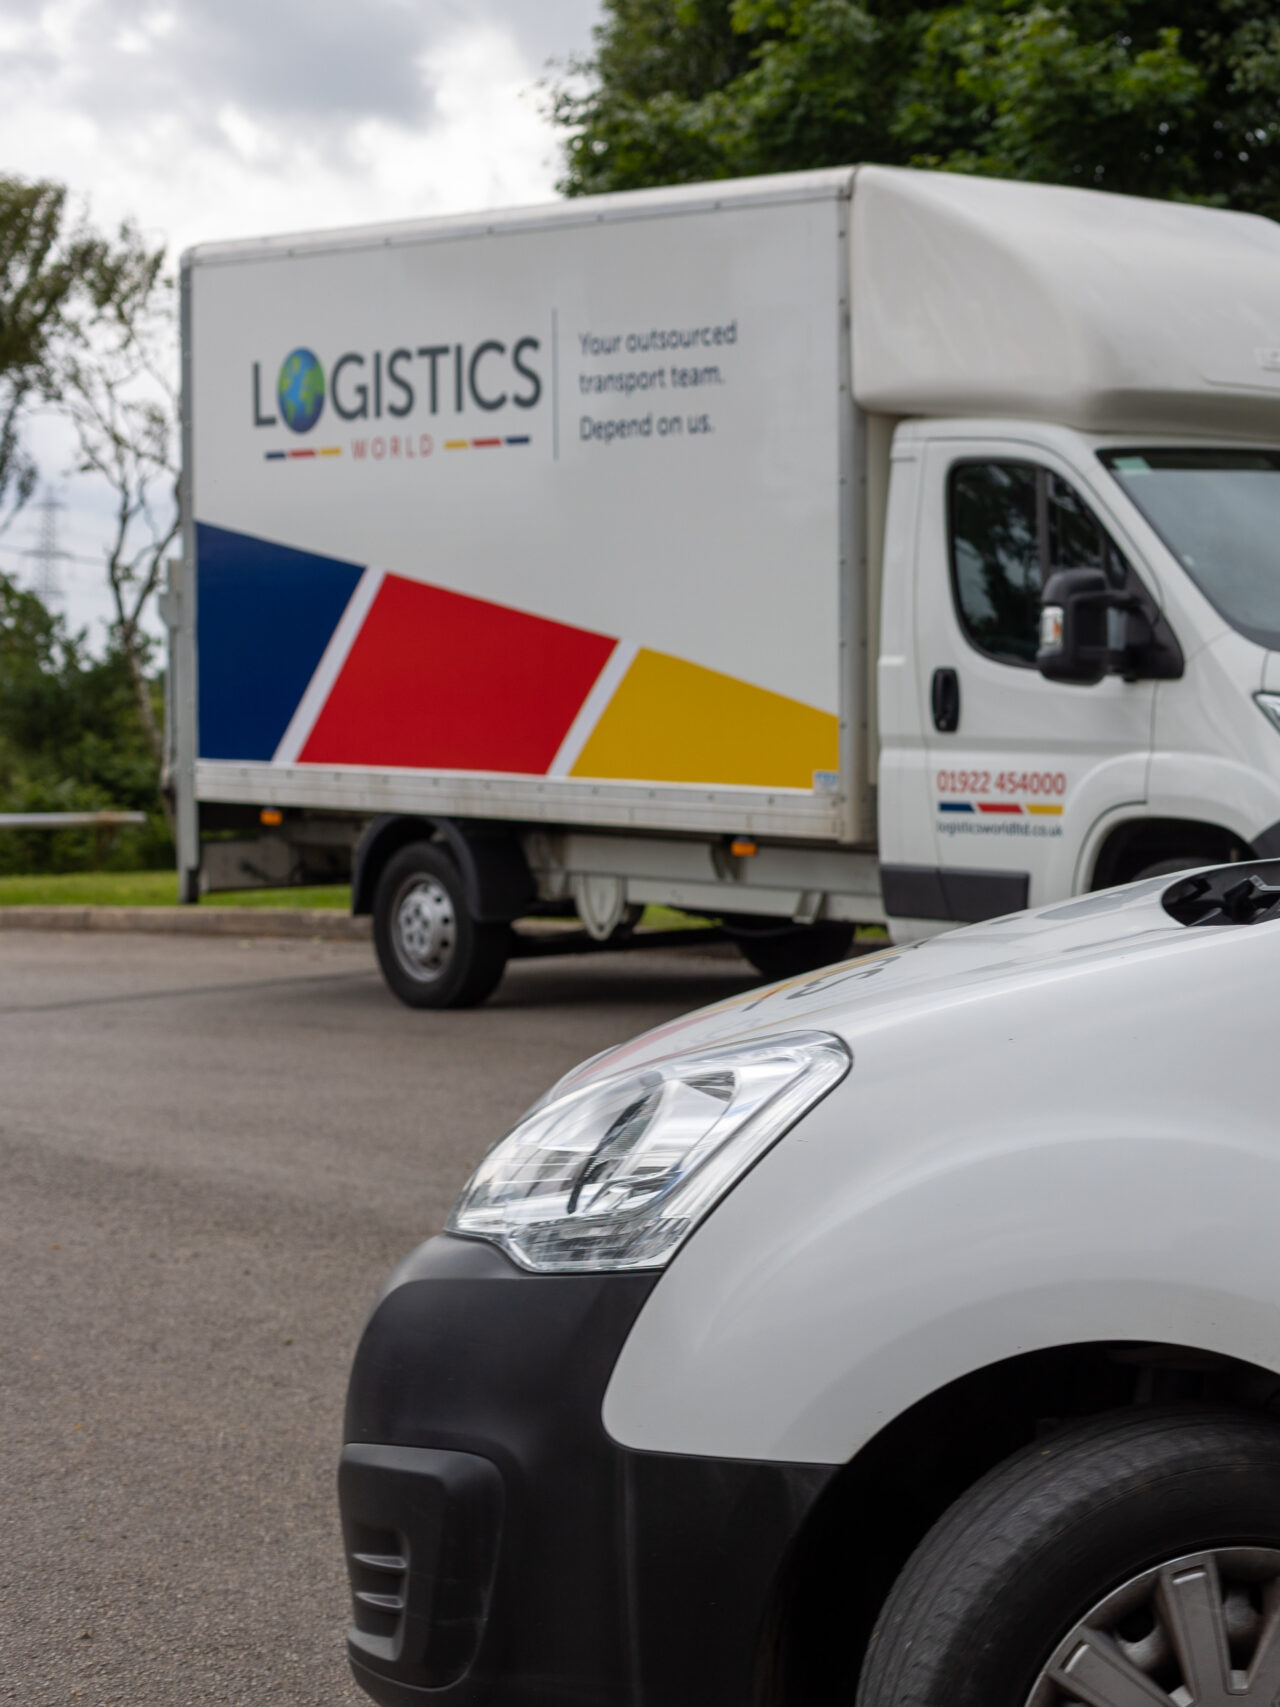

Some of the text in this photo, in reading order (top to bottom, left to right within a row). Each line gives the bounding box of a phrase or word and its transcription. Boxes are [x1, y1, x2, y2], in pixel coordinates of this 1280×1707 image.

[578, 320, 738, 357] Your outsourced
[252, 335, 544, 434] LOGISTICS
[578, 362, 726, 398] transport team.
[579, 412, 714, 444] Depend on us.
[351, 434, 435, 461] WORLD
[936, 769, 1068, 797] 01922 454000
[936, 819, 1064, 839] logisticsworldltd.co.uk
